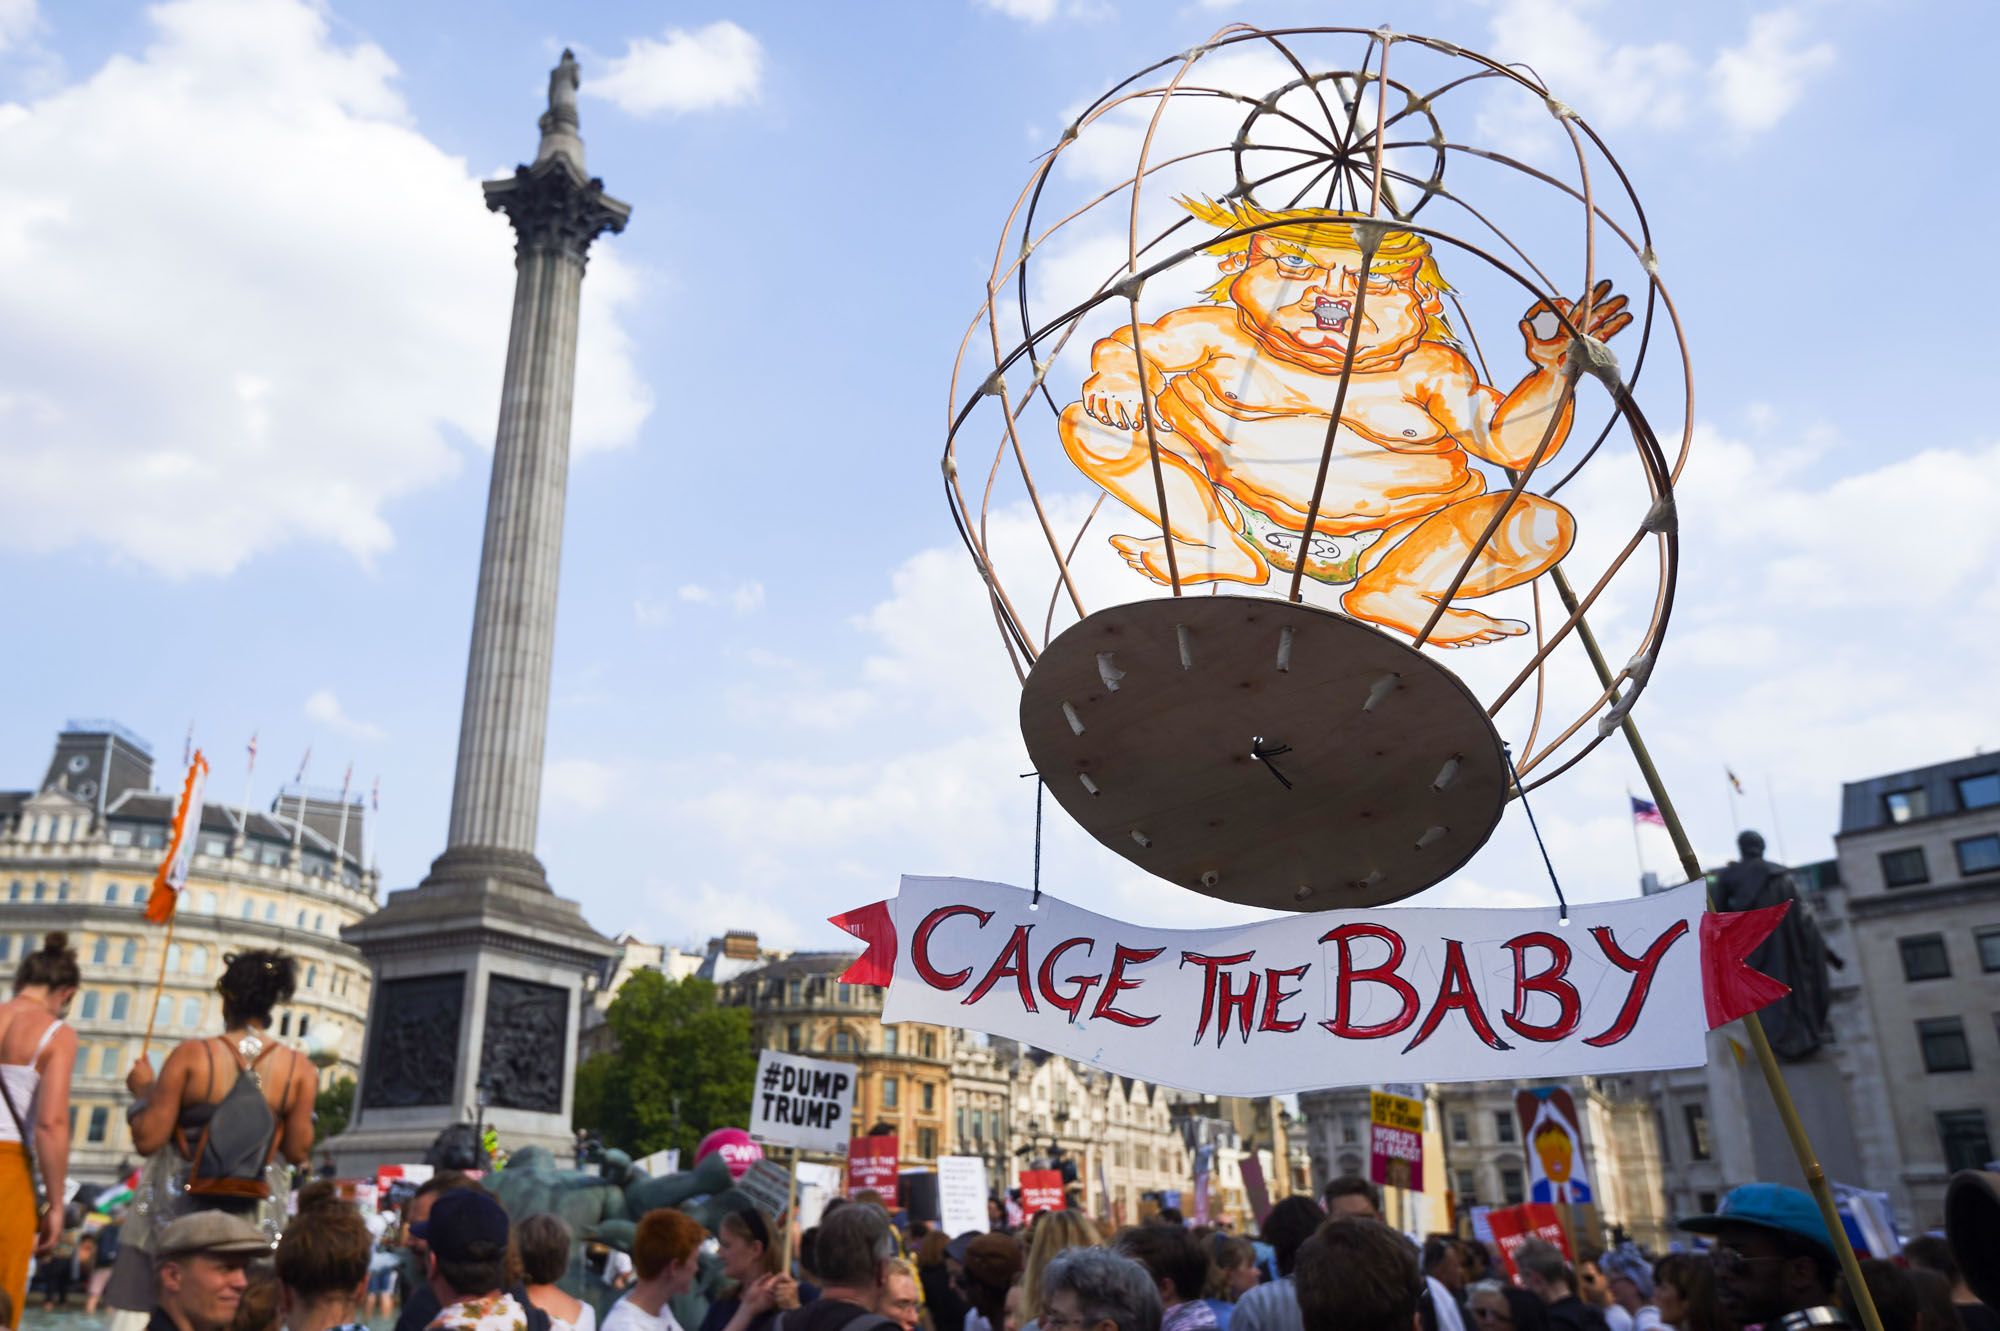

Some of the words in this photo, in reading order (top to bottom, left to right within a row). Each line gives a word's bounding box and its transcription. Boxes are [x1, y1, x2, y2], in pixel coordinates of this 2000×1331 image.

[911, 904, 1167, 1028] CAGE
[1179, 950, 1312, 1049] THE
[1317, 919, 1690, 1055] BABY
[762, 1061, 849, 1100] #DUMP
[762, 1092, 842, 1130] TRUMP
